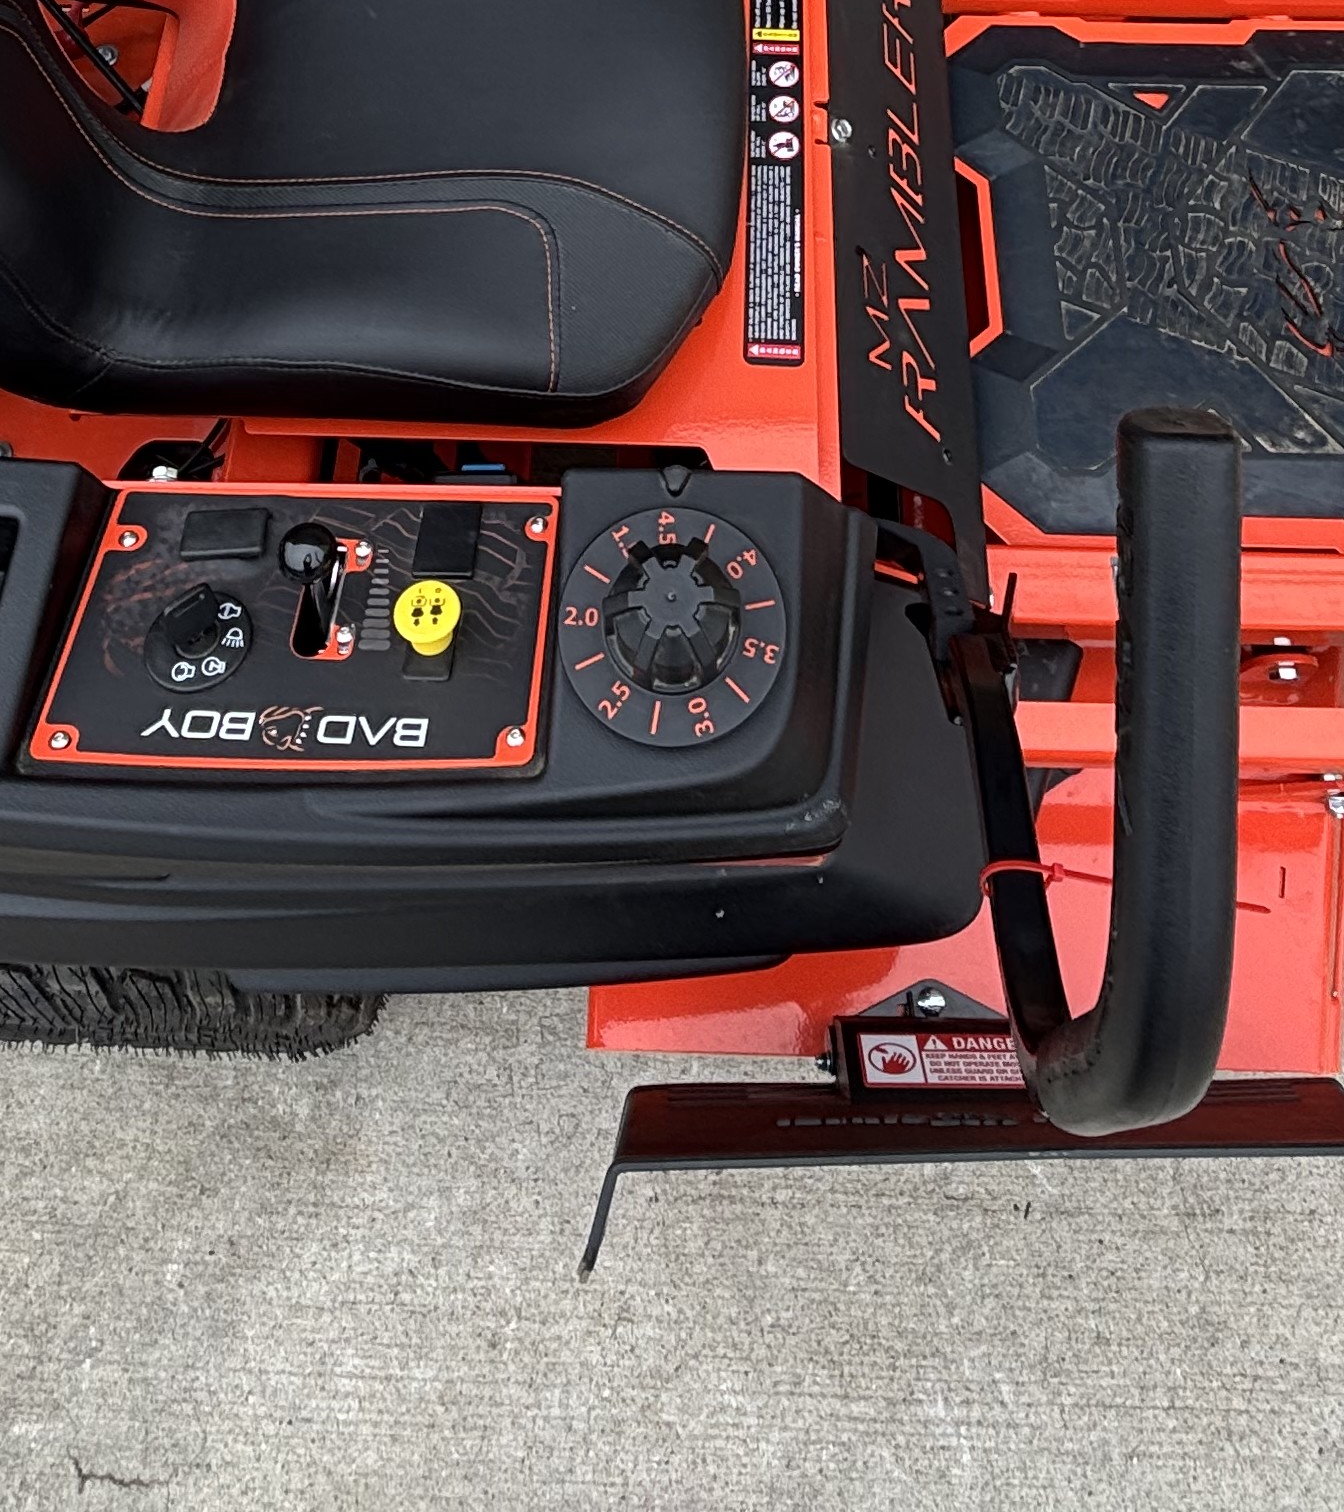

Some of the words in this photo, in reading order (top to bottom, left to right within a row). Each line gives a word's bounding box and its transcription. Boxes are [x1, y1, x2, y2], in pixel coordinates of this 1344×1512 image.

[861, 251, 893, 371] MZ
[657, 510, 678, 545] 4.5
[725, 548, 759, 580] 4.0
[562, 606, 600, 627] 2.0
[742, 636, 781, 665] 3.5
[597, 679, 633, 721] 2.5
[687, 696, 715, 738] 3.0
[140, 707, 257, 742] BOY
[316, 714, 430, 748] BAD
[952, 1036, 1016, 1051] DANGE
[989, 1075, 1023, 1083] ATTACH
